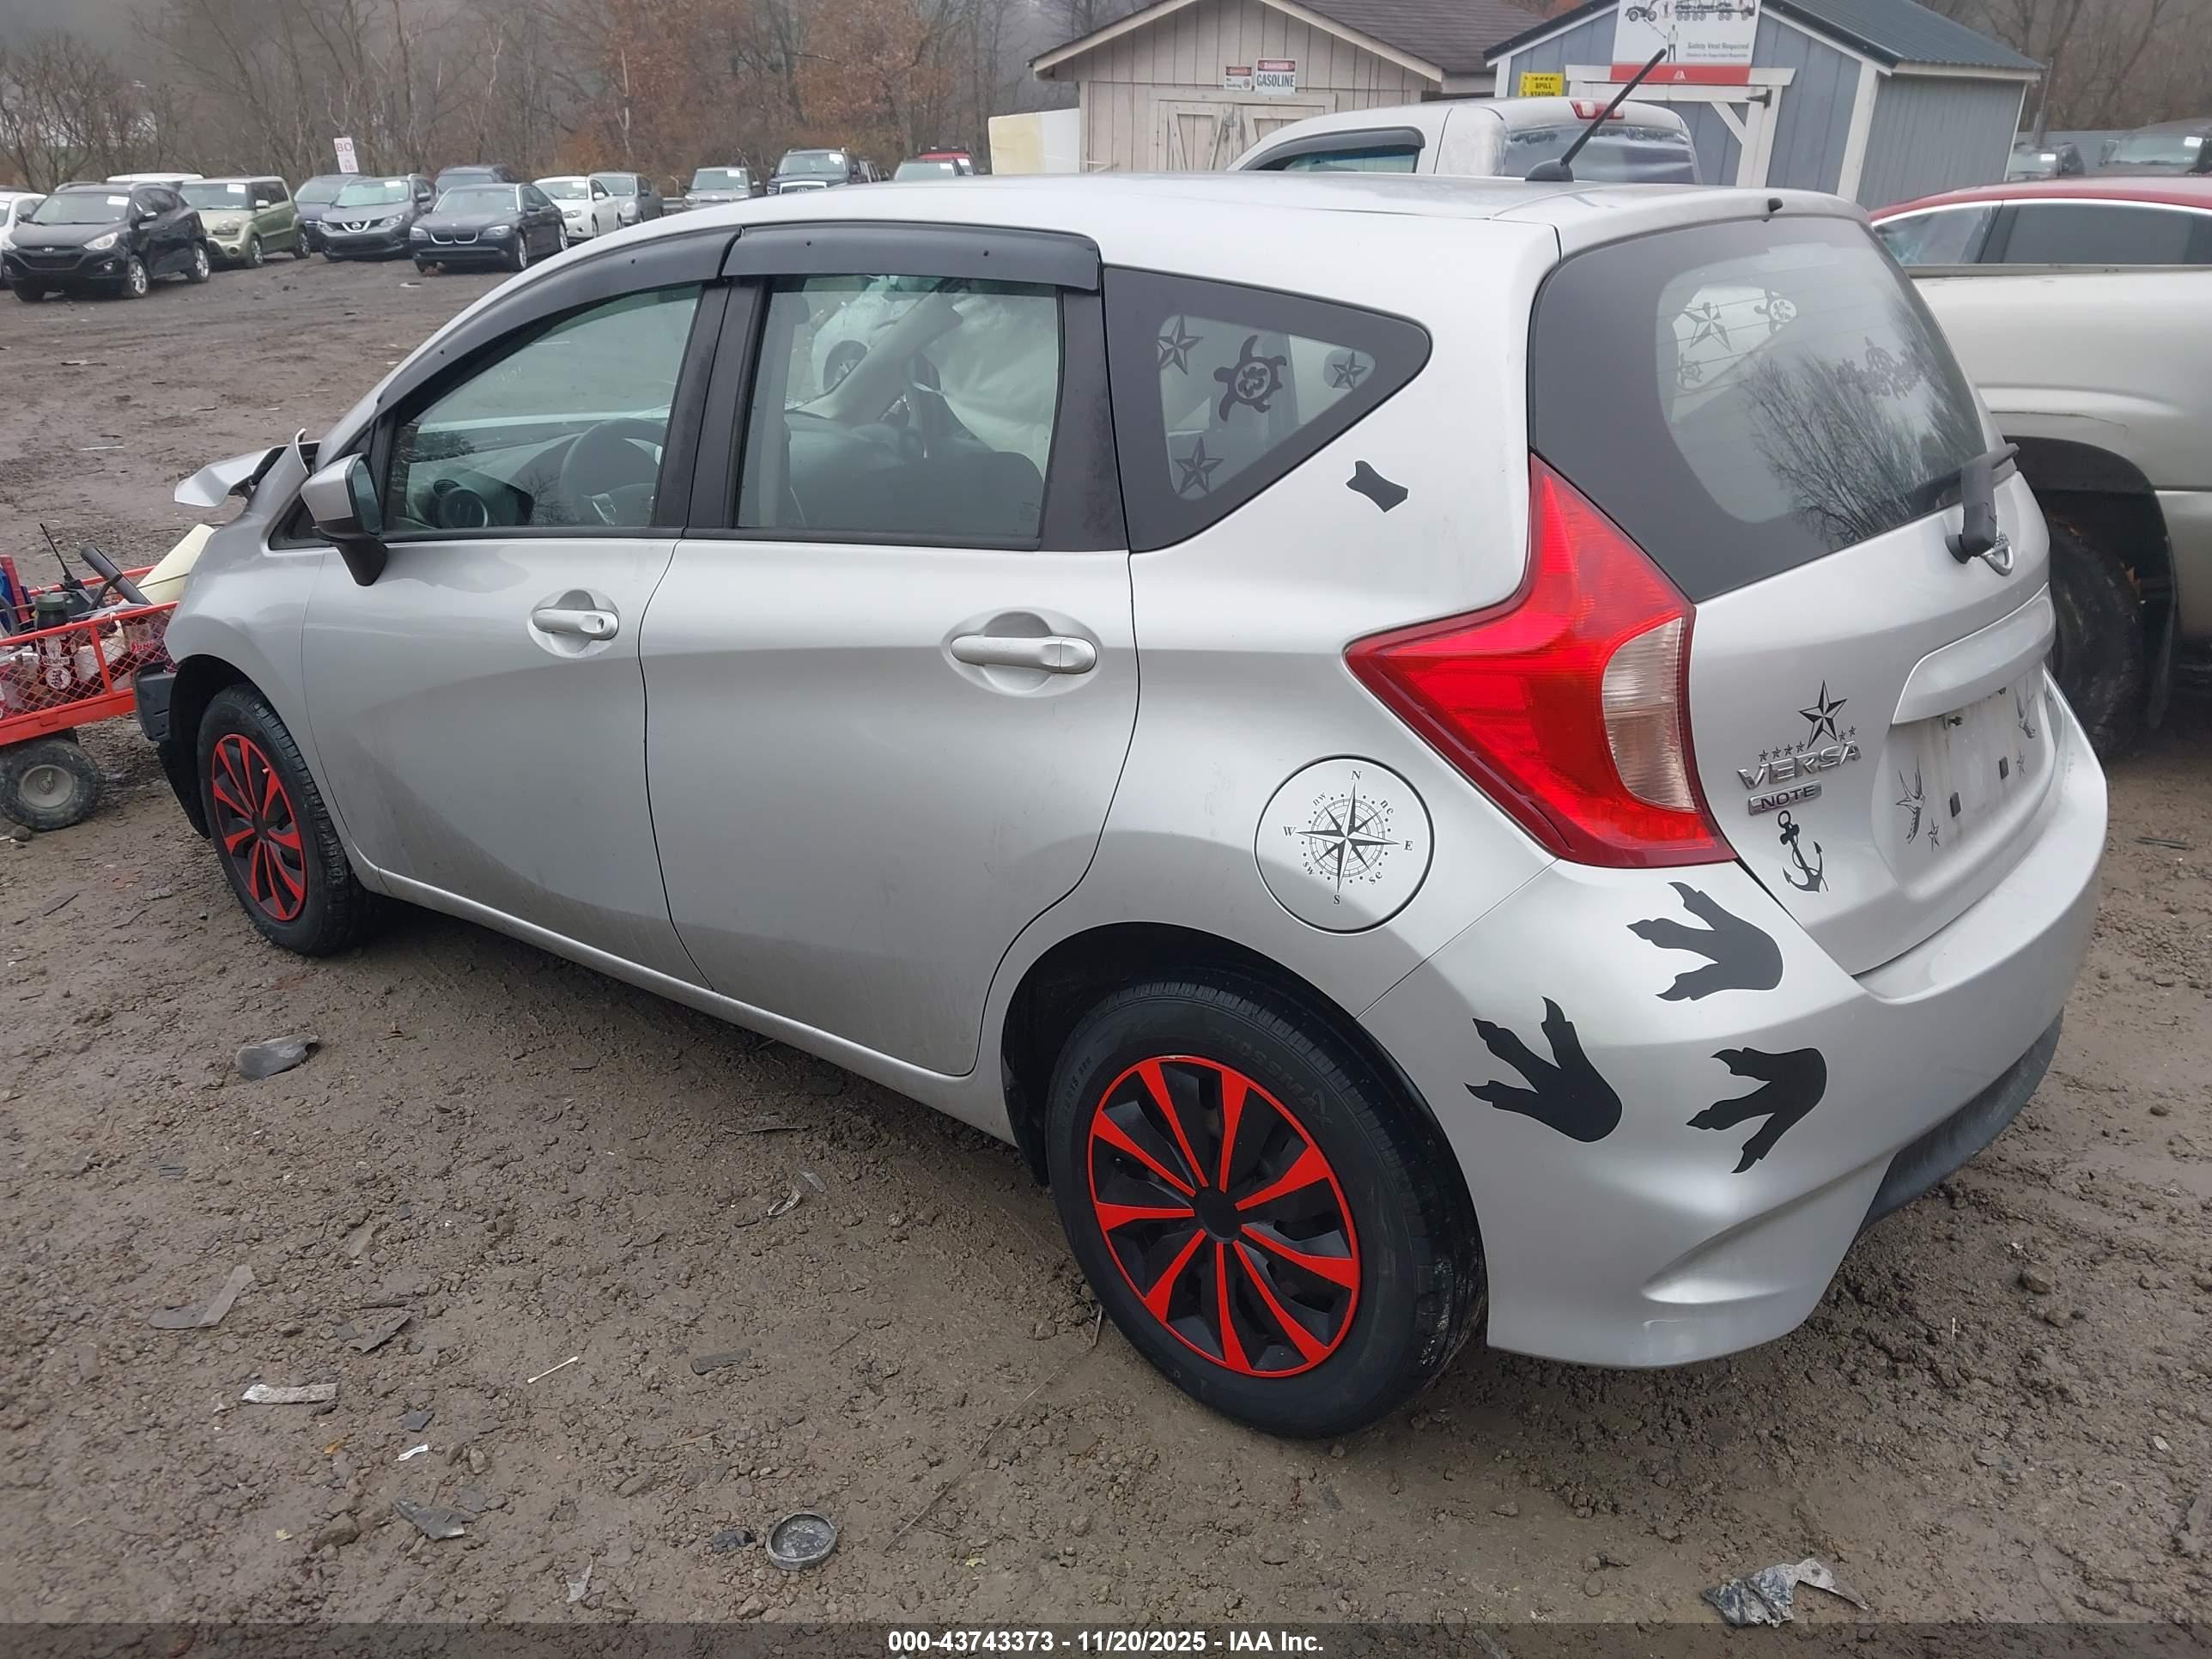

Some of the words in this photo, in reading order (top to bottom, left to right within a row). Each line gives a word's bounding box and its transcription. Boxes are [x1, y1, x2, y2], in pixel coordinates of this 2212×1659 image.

[1256, 74, 1295, 88] GASOLINE
[1736, 740, 1863, 790] VERSA
[1351, 770, 1363, 781] N
[1760, 784, 1818, 811] NOTE
[1380, 799, 1394, 816] ne
[1283, 826, 1297, 837] W
[1403, 841, 1413, 851] E
[1369, 871, 1382, 885] se
[1333, 894, 1341, 905] S
